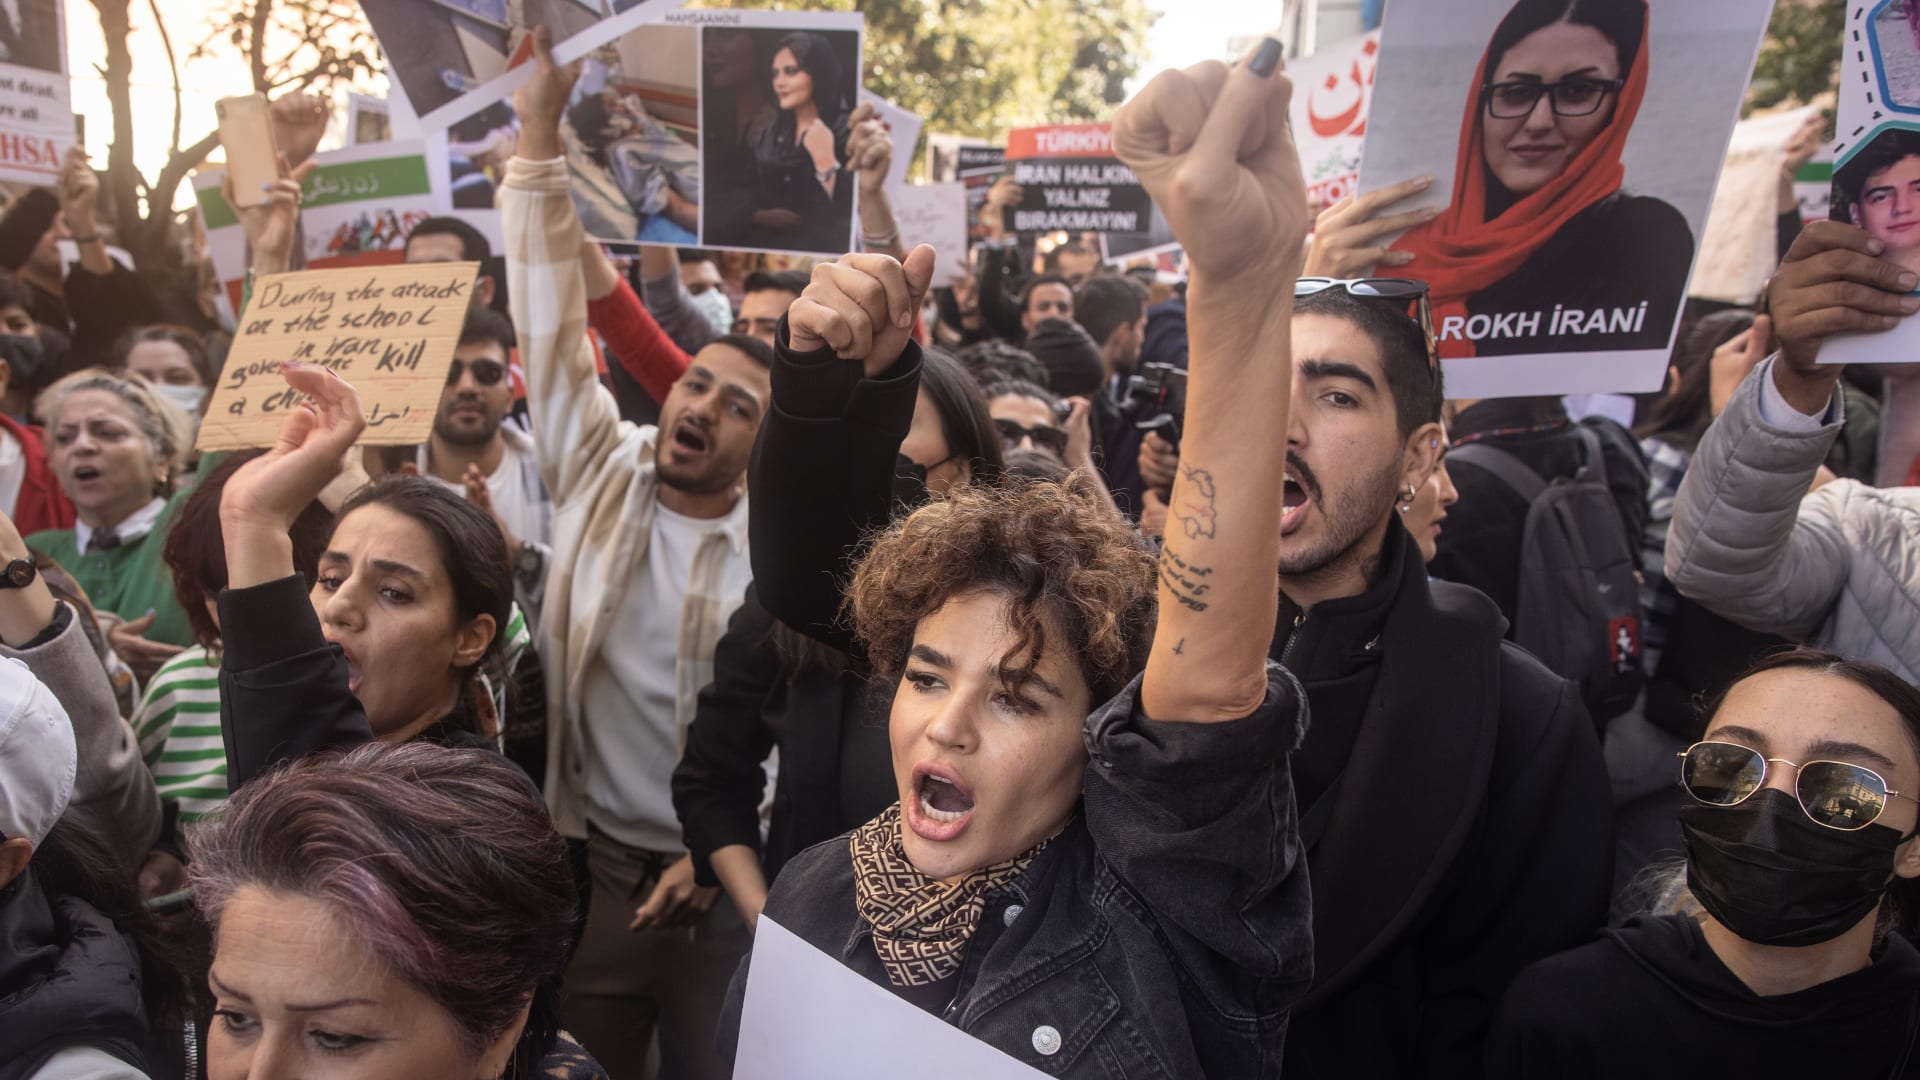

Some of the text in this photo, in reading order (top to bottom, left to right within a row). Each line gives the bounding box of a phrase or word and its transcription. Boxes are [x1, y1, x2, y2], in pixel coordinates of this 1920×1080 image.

[1014, 161, 1061, 185] İRAN
[1043, 187, 1111, 208] YALNIZ
[258, 281, 334, 313] During
[347, 277, 385, 302] the
[245, 319, 273, 336] on
[283, 305, 329, 333] the
[1434, 300, 1649, 342] ROKH İRANİ
[292, 340, 316, 357] in
[228, 397, 247, 415] a
